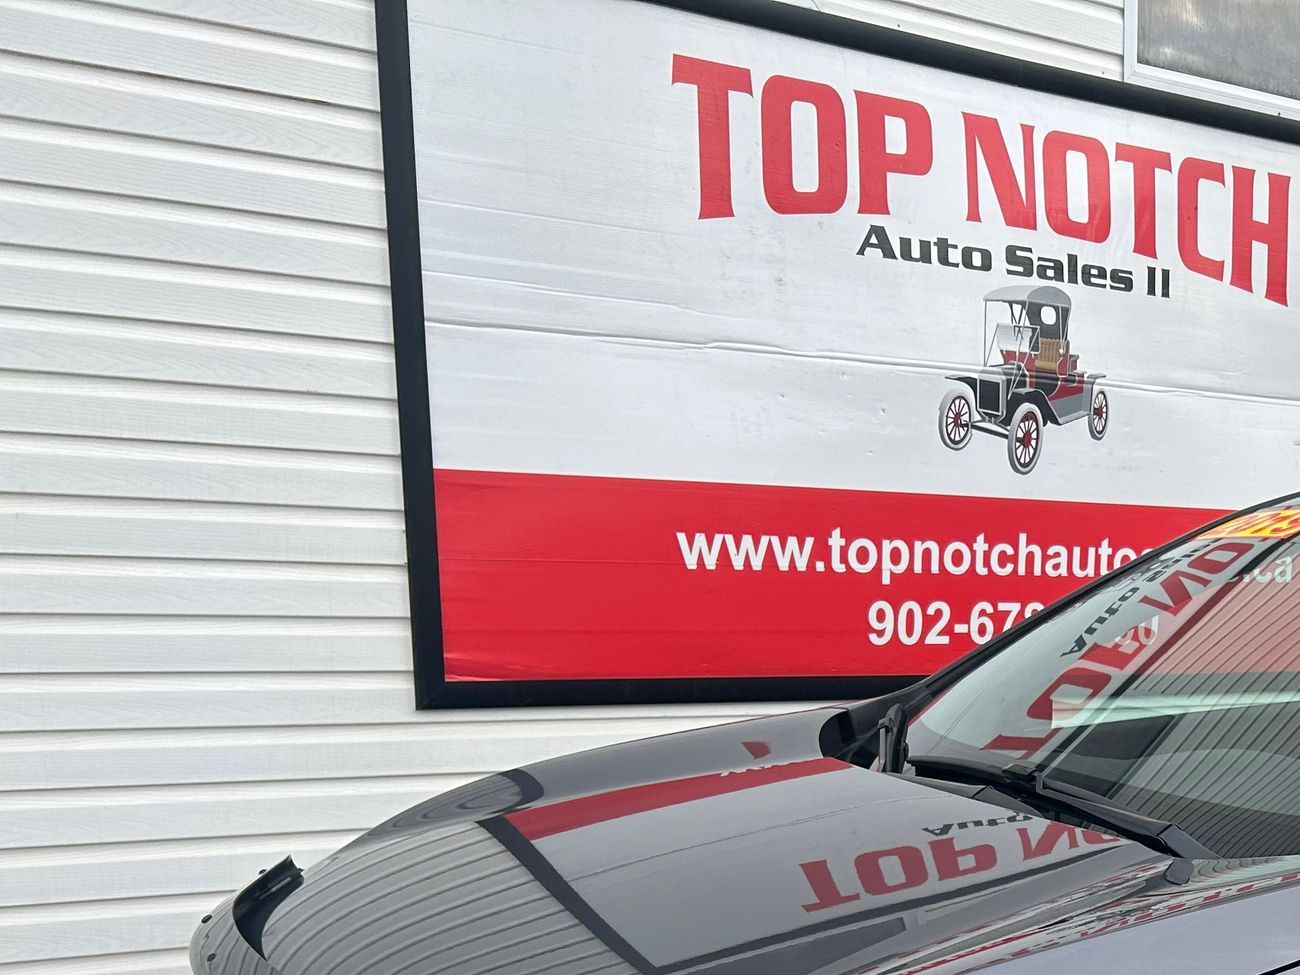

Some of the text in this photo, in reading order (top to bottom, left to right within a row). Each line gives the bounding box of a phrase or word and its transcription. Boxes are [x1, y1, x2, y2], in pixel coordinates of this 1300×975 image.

[672, 53, 1291, 307] TOP NOTCH
[856, 224, 992, 273] Auto
[1004, 244, 1134, 292] Sales
